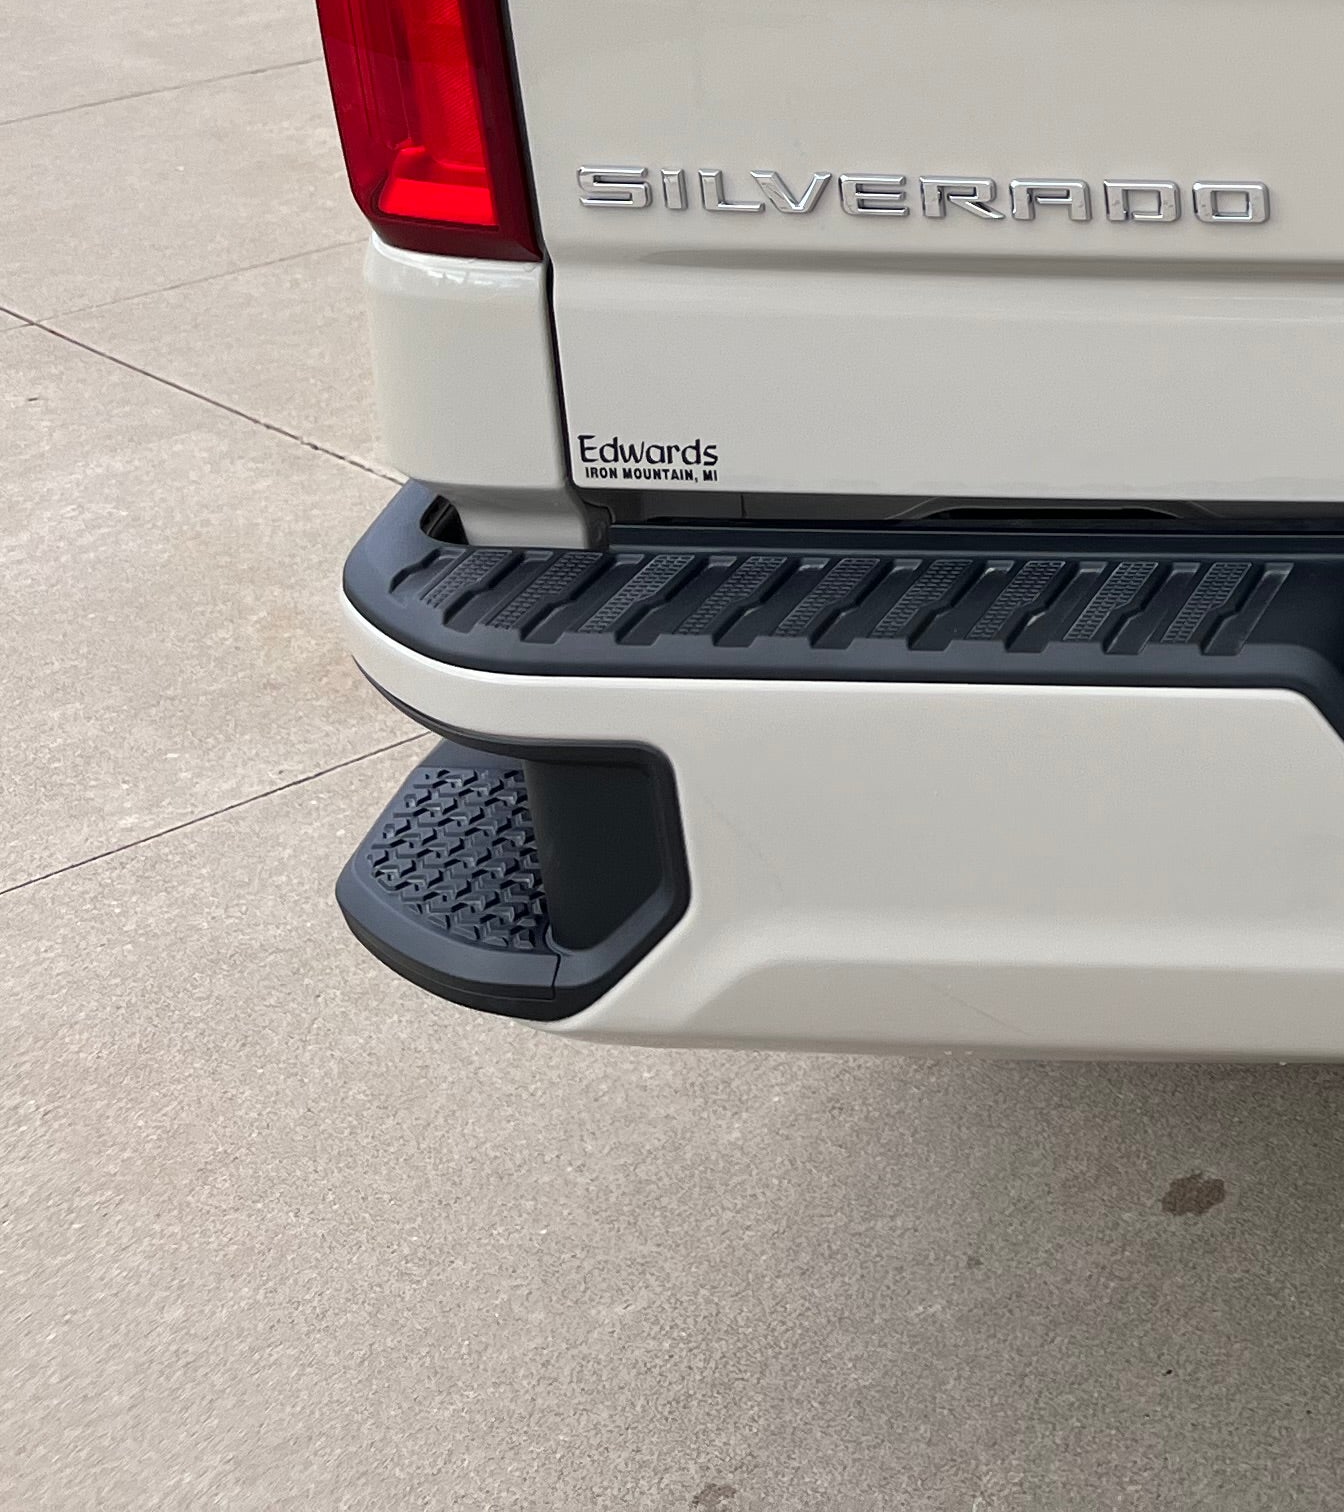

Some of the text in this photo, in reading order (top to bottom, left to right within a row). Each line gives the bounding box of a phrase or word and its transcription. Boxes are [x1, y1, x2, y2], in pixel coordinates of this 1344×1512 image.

[576, 165, 1272, 224] SILVERADO
[577, 435, 719, 466] Edwards
[585, 467, 718, 483] IRON MOUNTAIN, MI
